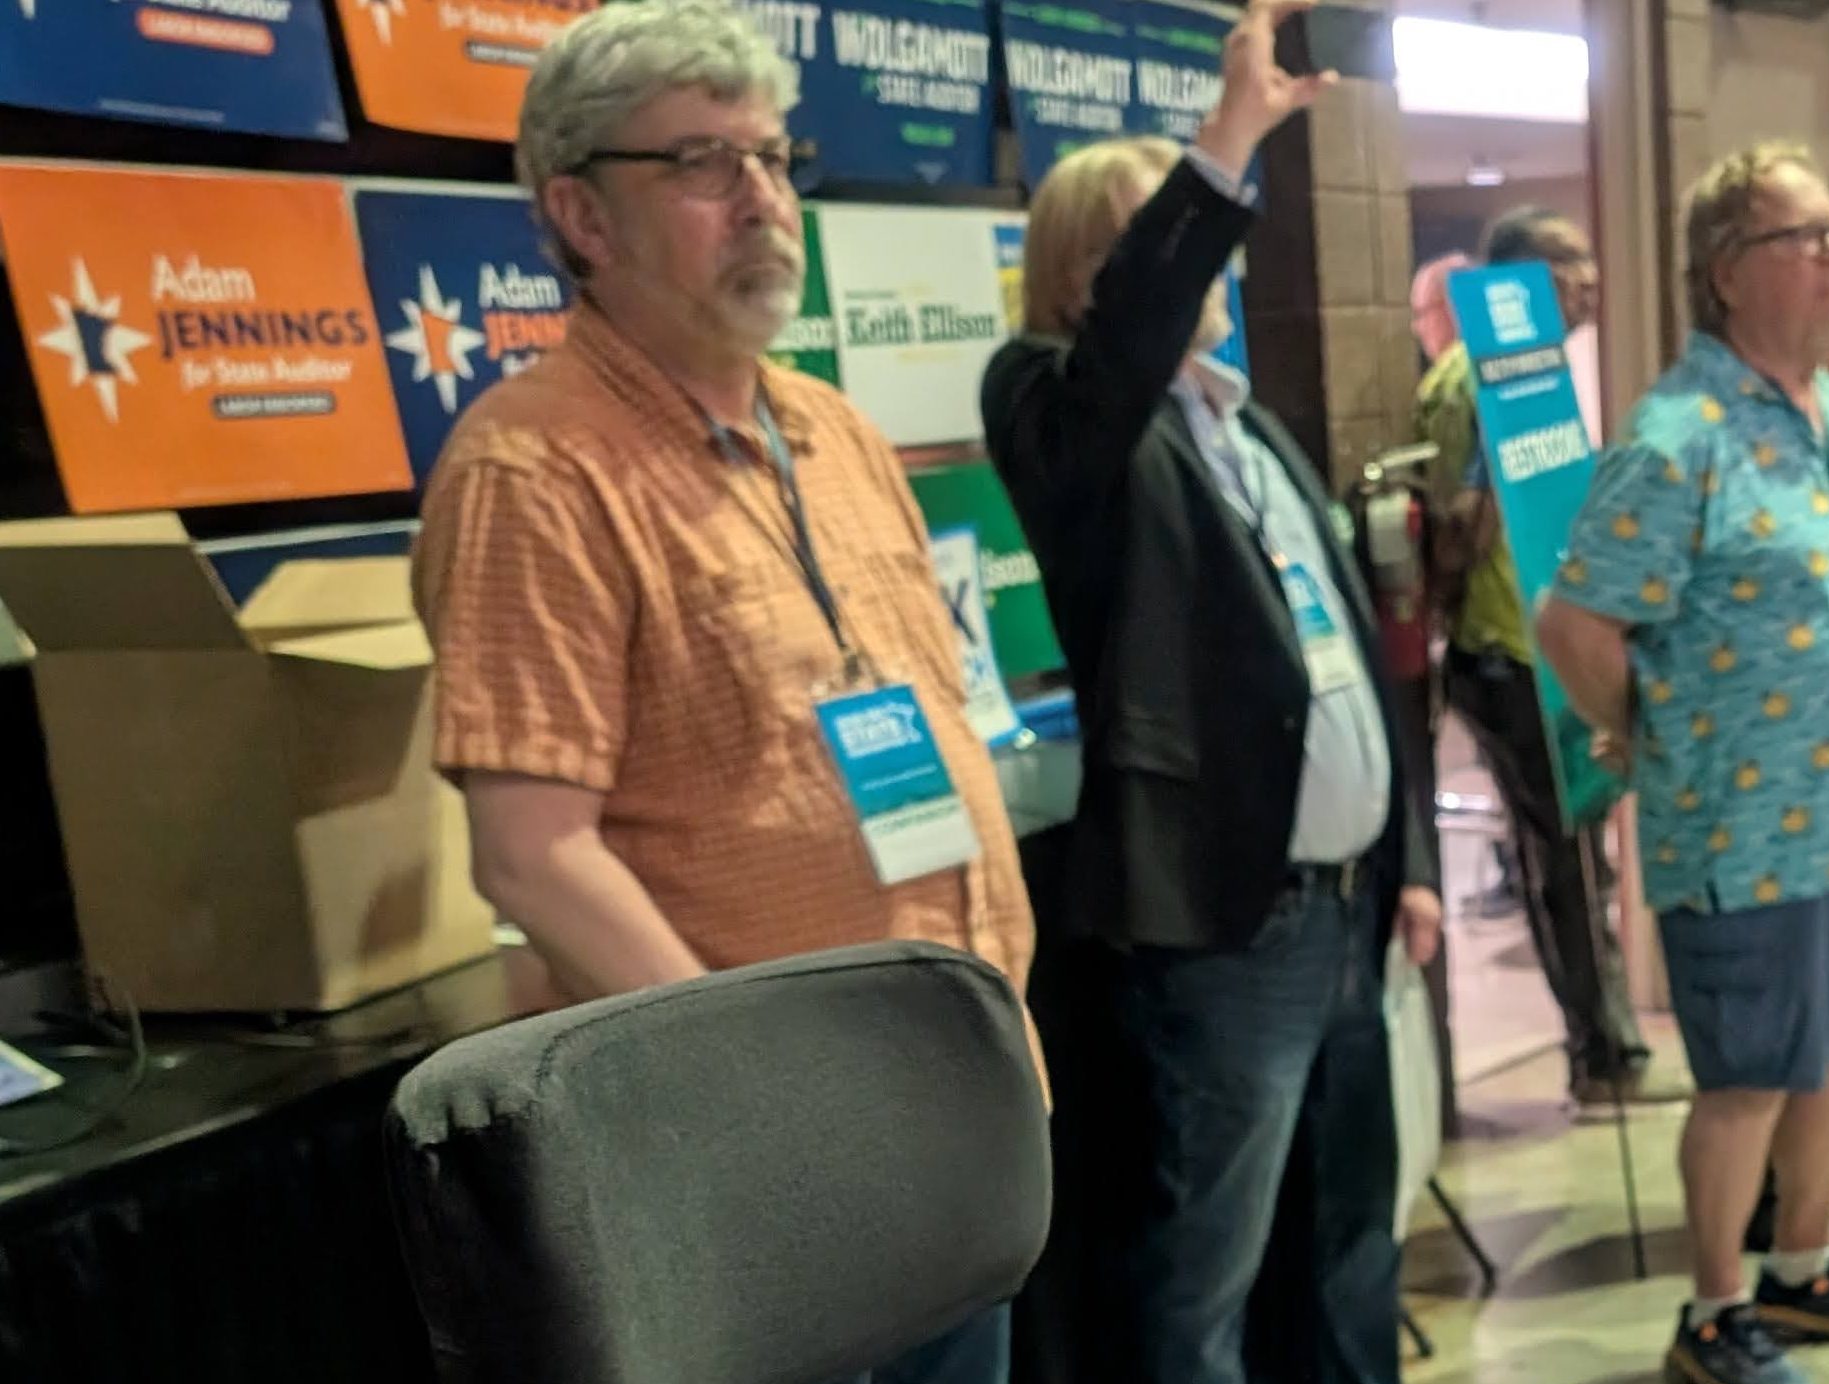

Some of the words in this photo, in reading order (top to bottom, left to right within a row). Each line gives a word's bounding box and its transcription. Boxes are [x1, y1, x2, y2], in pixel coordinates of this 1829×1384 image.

[154, 253, 256, 302] Adam
[479, 262, 562, 309] Adam
[156, 307, 368, 361] JENNINGS
[845, 303, 912, 346] Keith
